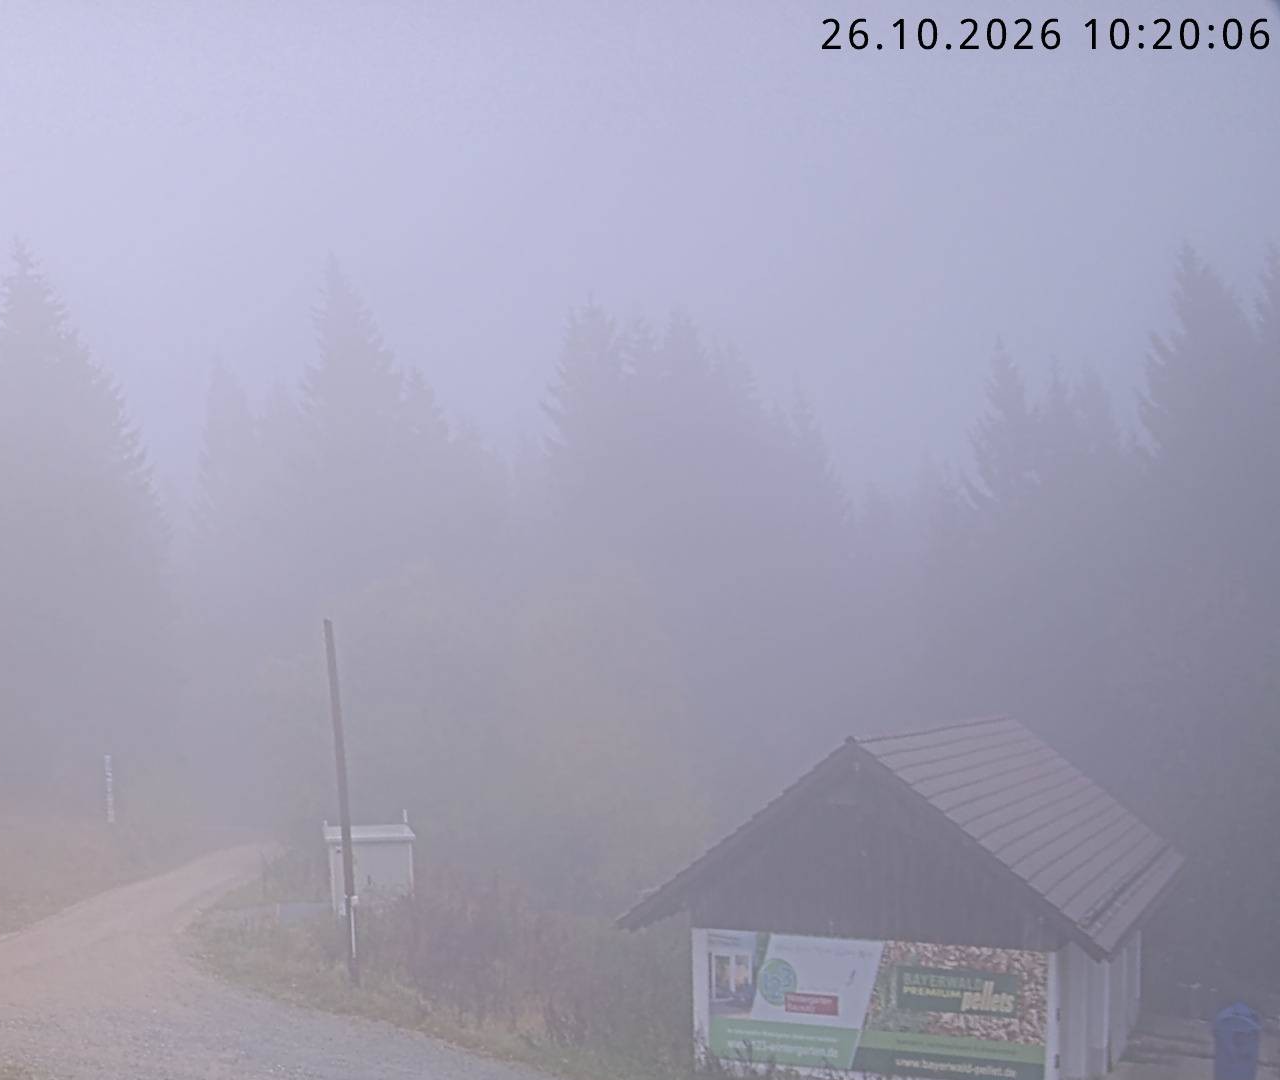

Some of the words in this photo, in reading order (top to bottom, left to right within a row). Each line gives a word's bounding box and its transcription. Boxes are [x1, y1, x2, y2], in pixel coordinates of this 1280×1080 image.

[902, 985, 962, 998] PREMIUM
[903, 971, 985, 992] BAYERWALD
[960, 981, 1016, 1013] pellets
[894, 1058, 1018, 1079] www.bayerwald-pellet.de
